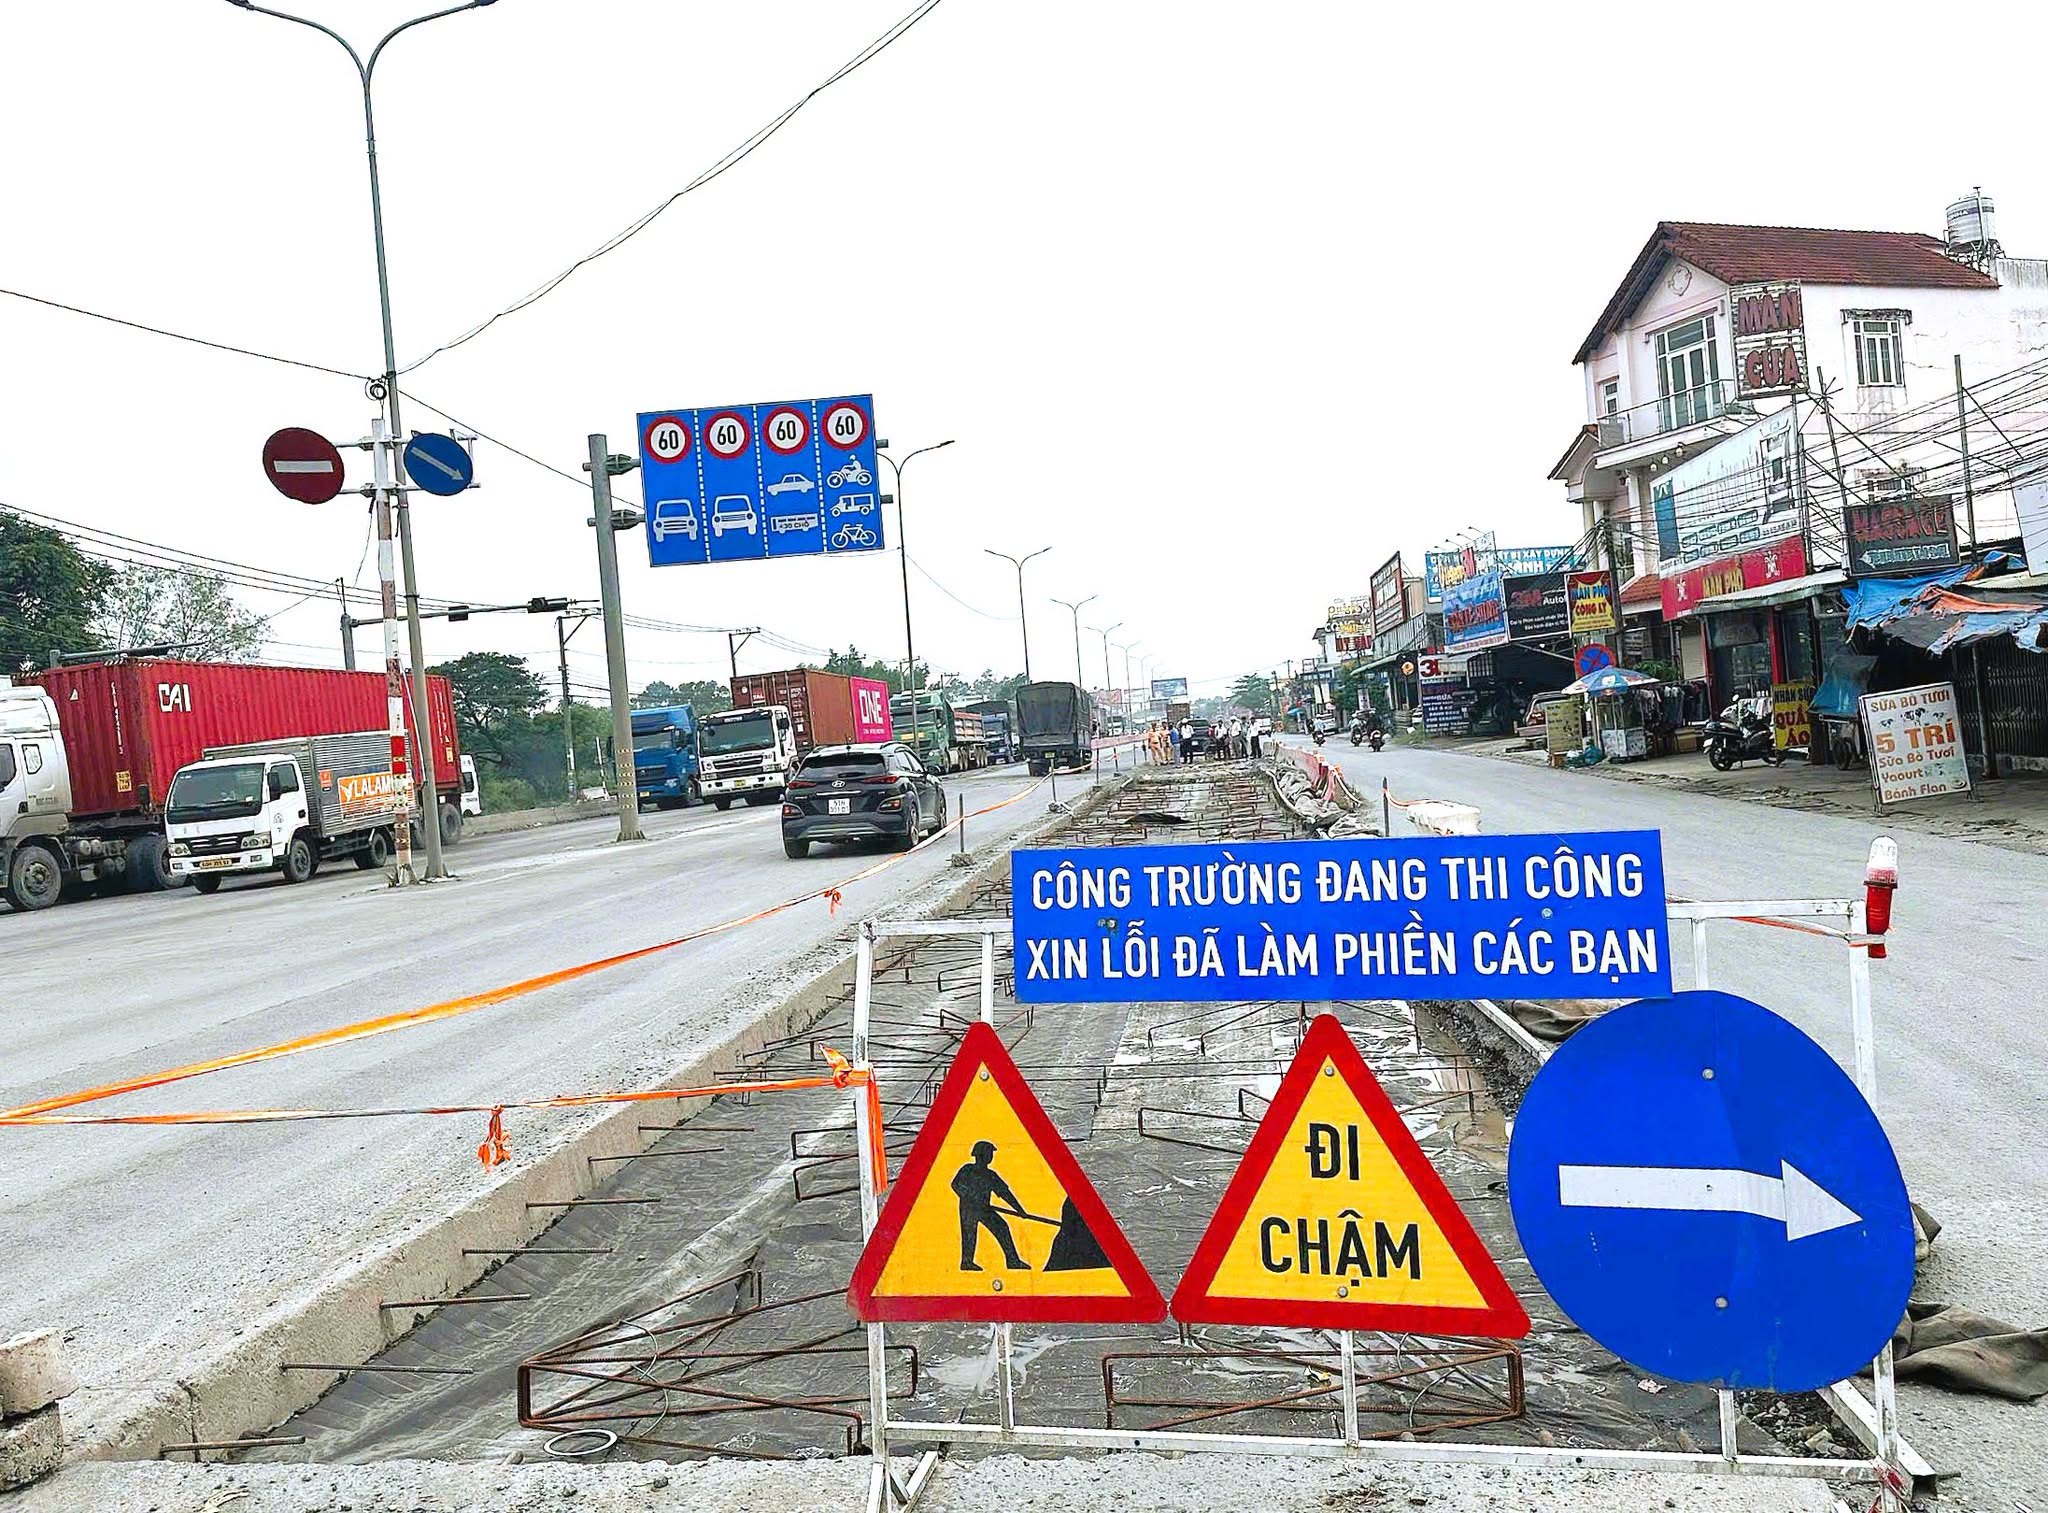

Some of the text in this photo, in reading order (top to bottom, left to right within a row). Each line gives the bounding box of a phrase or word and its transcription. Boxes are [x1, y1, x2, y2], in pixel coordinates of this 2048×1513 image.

[717, 424, 737, 445] 60
[776, 420, 797, 441] 60
[835, 415, 855, 436] 60
[658, 429, 679, 451] 60
[158, 683, 192, 712] CAI
[859, 688, 884, 724] ONE
[1870, 688, 1950, 713] SỮA BÒ TƯƠI
[1875, 732, 1896, 754] 5
[1879, 746, 1955, 768] Sữa Bò Tươi
[1881, 768, 1924, 783] Yaourt
[1884, 783, 1947, 800] Bánh Flan
[1032, 846, 1643, 910] CÔNG TRƯỜNG ĐANG THI CÔNG
[1026, 910, 1658, 983] XIN LỖI ĐÃ LÀM PHIỀN CÁC BẠN
[1304, 1122, 1360, 1181] ĐI
[1260, 1209, 1422, 1287] CHẬM
